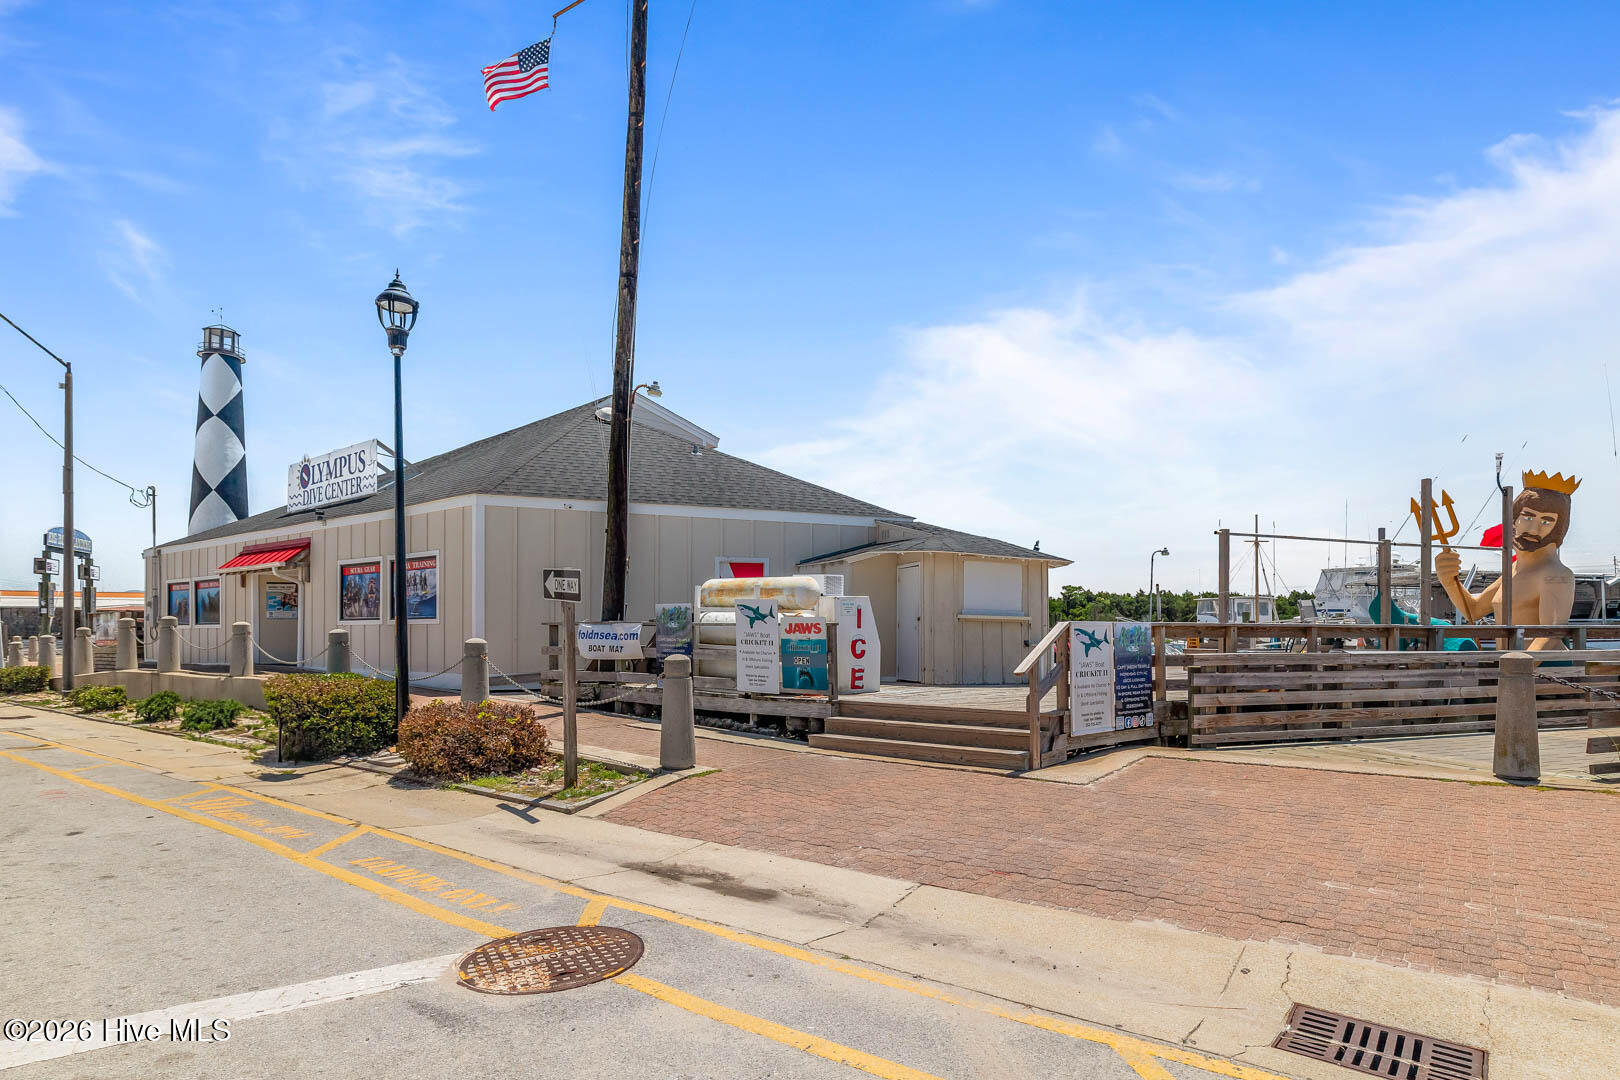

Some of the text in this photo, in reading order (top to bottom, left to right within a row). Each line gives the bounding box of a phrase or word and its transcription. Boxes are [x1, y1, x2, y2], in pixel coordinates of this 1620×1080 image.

[300, 450, 366, 489] OLYMPUS
[303, 477, 362, 506] DIVE CENTER
[554, 579, 577, 591] ONE WAY
[785, 622, 822, 635] JAWS
[588, 644, 624, 653] BOAT MAT
[851, 607, 867, 690] ICE
[794, 656, 810, 665] OPEN
[1076, 670, 1102, 678] CRICKET
